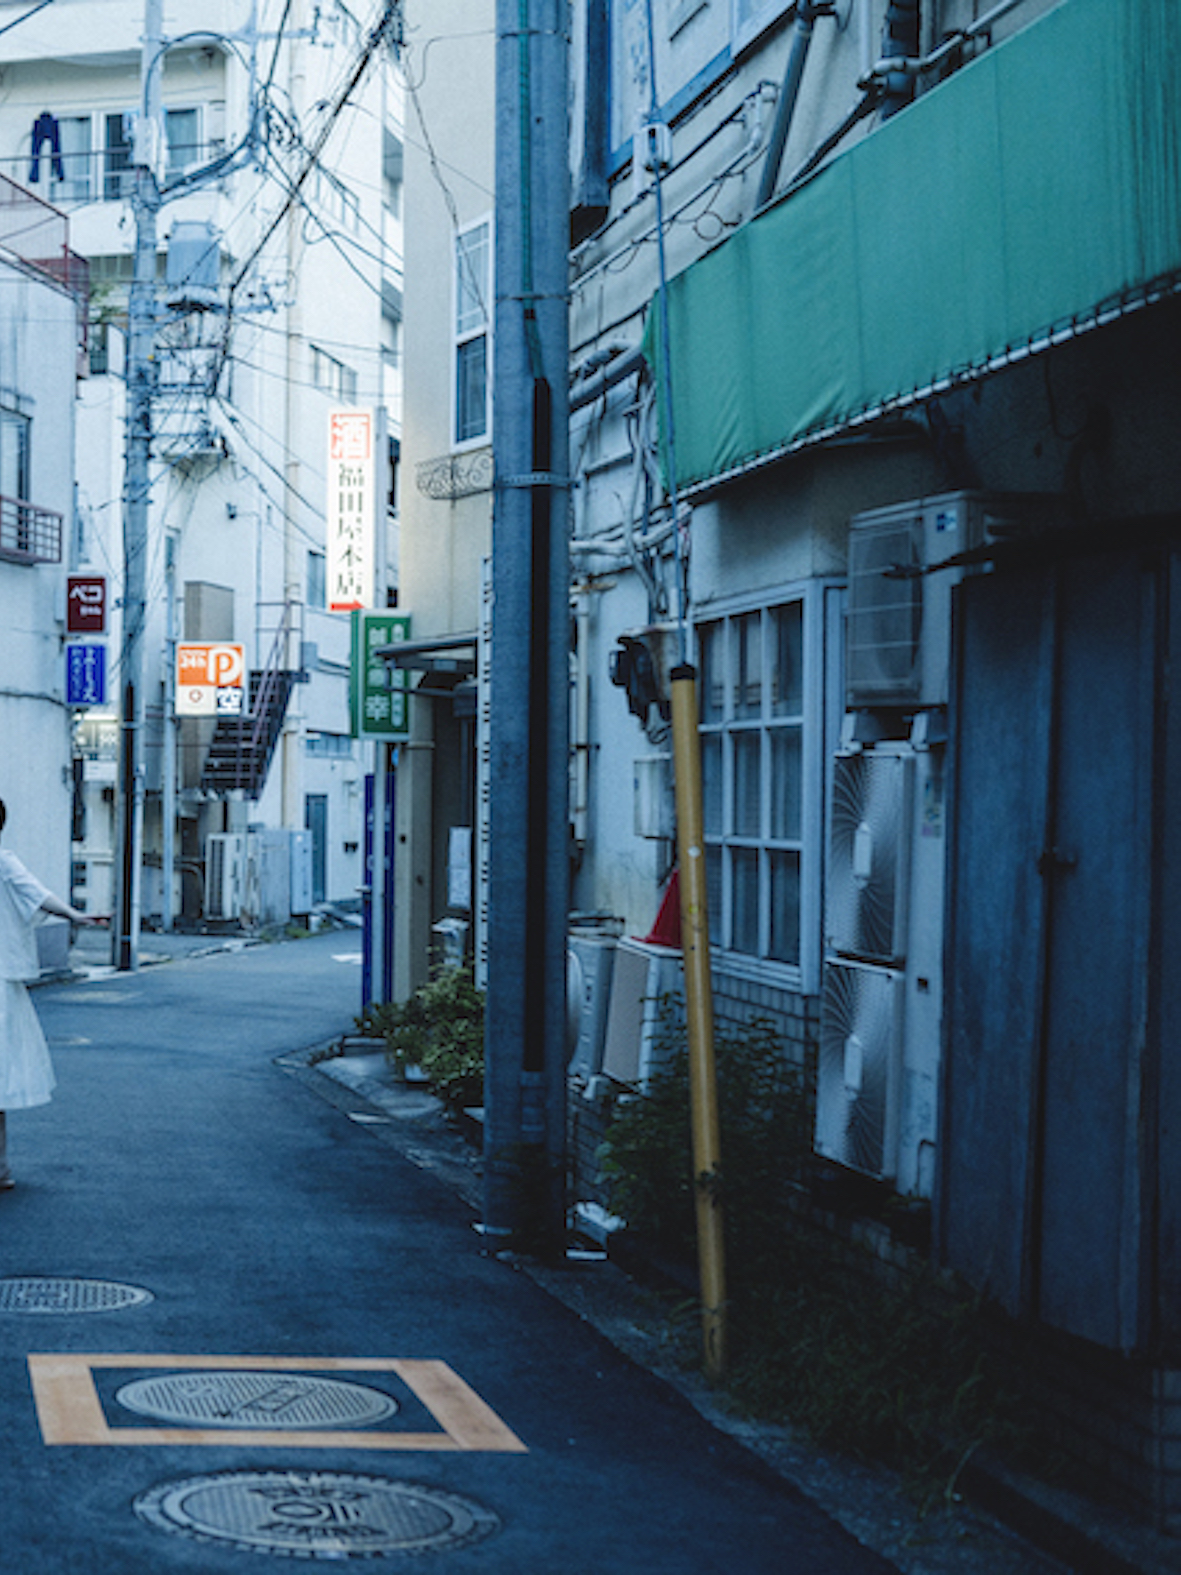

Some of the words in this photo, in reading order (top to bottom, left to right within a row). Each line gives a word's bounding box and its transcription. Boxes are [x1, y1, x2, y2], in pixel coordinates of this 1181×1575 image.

[331, 414, 370, 459] 酒
[208, 648, 240, 684] P
[217, 687, 241, 714] 空
